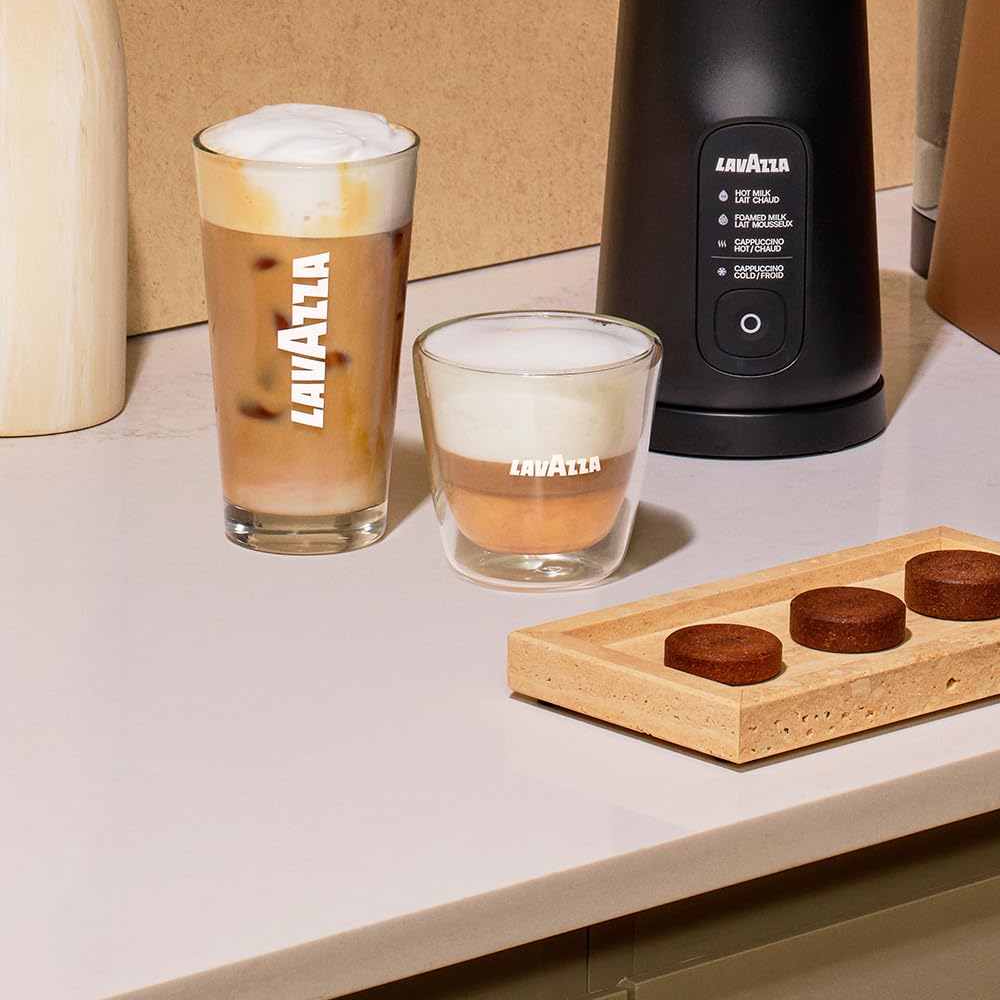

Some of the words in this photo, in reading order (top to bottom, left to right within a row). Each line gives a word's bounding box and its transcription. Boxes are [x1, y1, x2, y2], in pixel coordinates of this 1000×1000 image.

[715, 153, 791, 174] LAVAZZA
[735, 189, 751, 197] HOT
[752, 189, 771, 197] MILK
[735, 196, 750, 204] LAIT
[752, 196, 780, 204] CHAUD
[735, 214, 767, 222] FOAMED
[768, 213, 787, 221] MILK
[752, 220, 793, 228] MOUSSEUX
[734, 238, 785, 246] CAPPUCCINO
[734, 264, 784, 272] CAPPUCCINO
[277, 252, 330, 428] LAVAZZA
[509, 454, 601, 477] LAVAZZA
